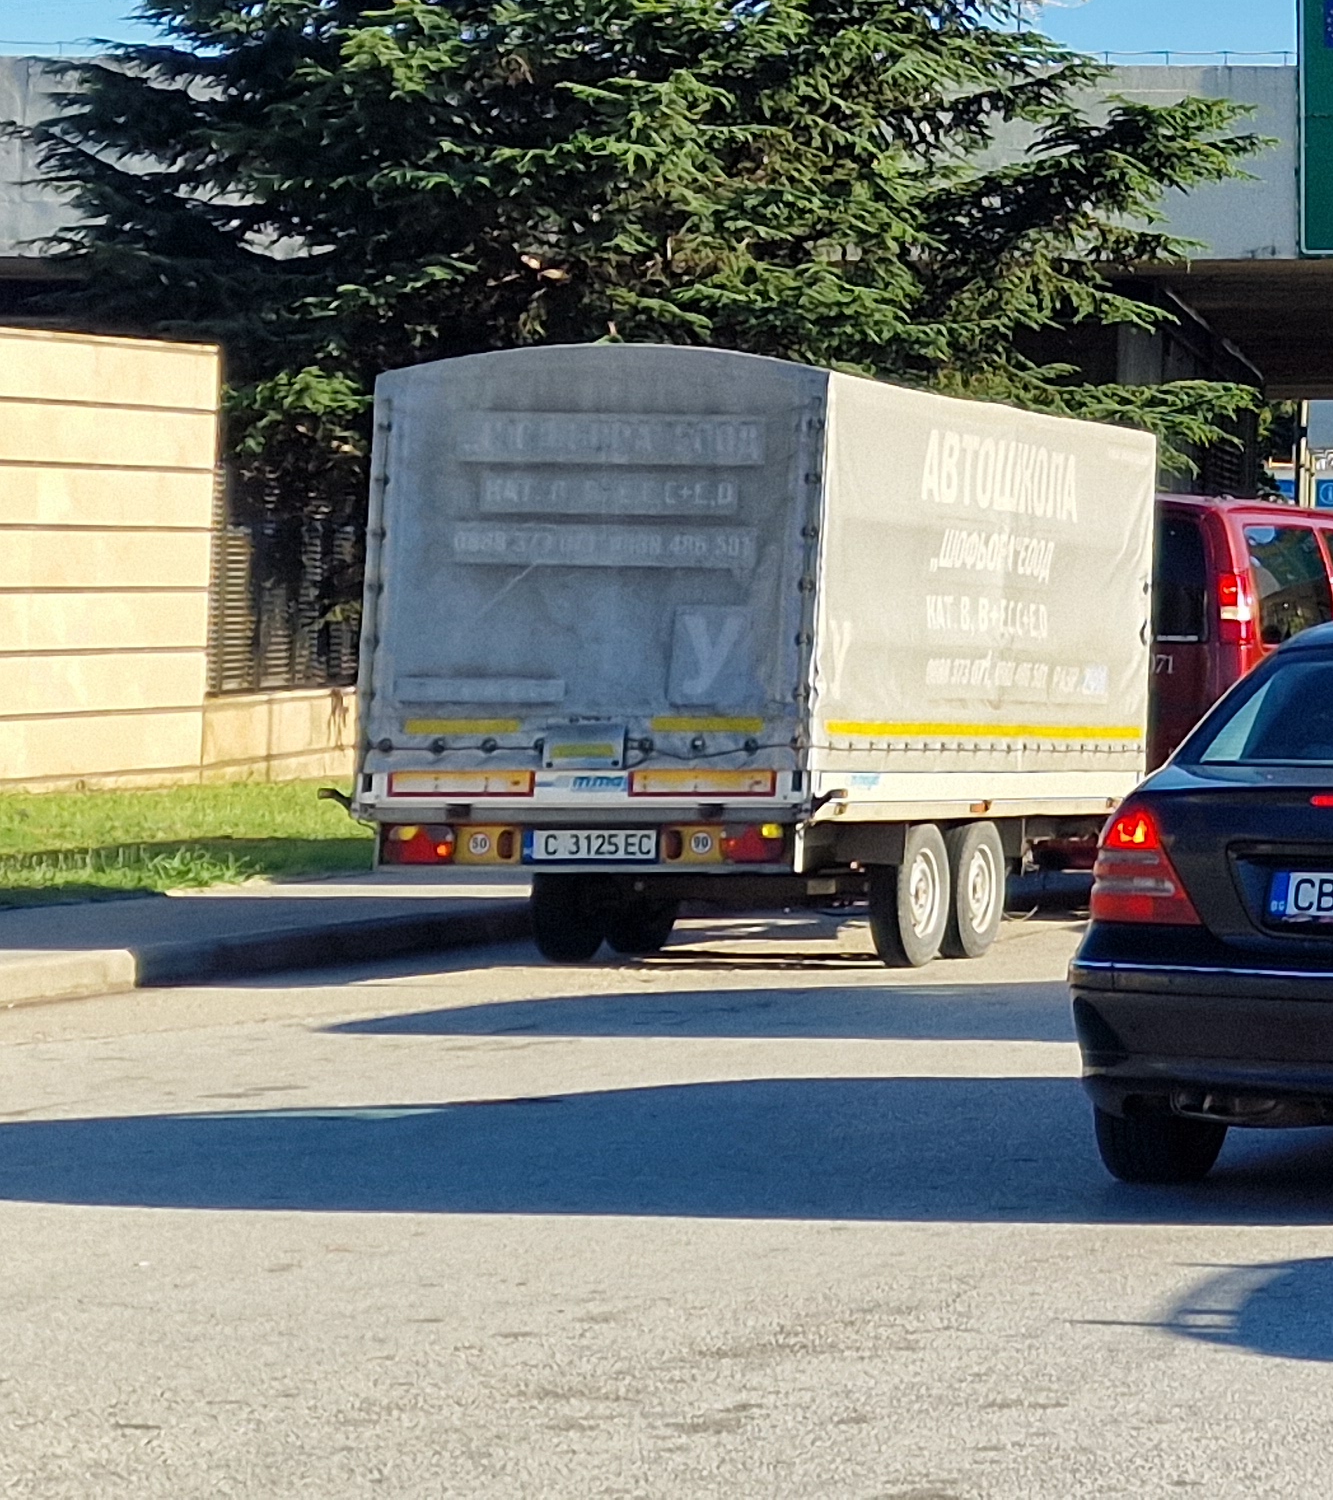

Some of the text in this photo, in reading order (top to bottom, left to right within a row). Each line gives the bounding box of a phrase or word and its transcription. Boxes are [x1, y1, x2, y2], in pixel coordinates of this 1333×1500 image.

[921, 428, 1078, 524] АВТОШКОЛА
[544, 833, 652, 855] C 3125 EC
